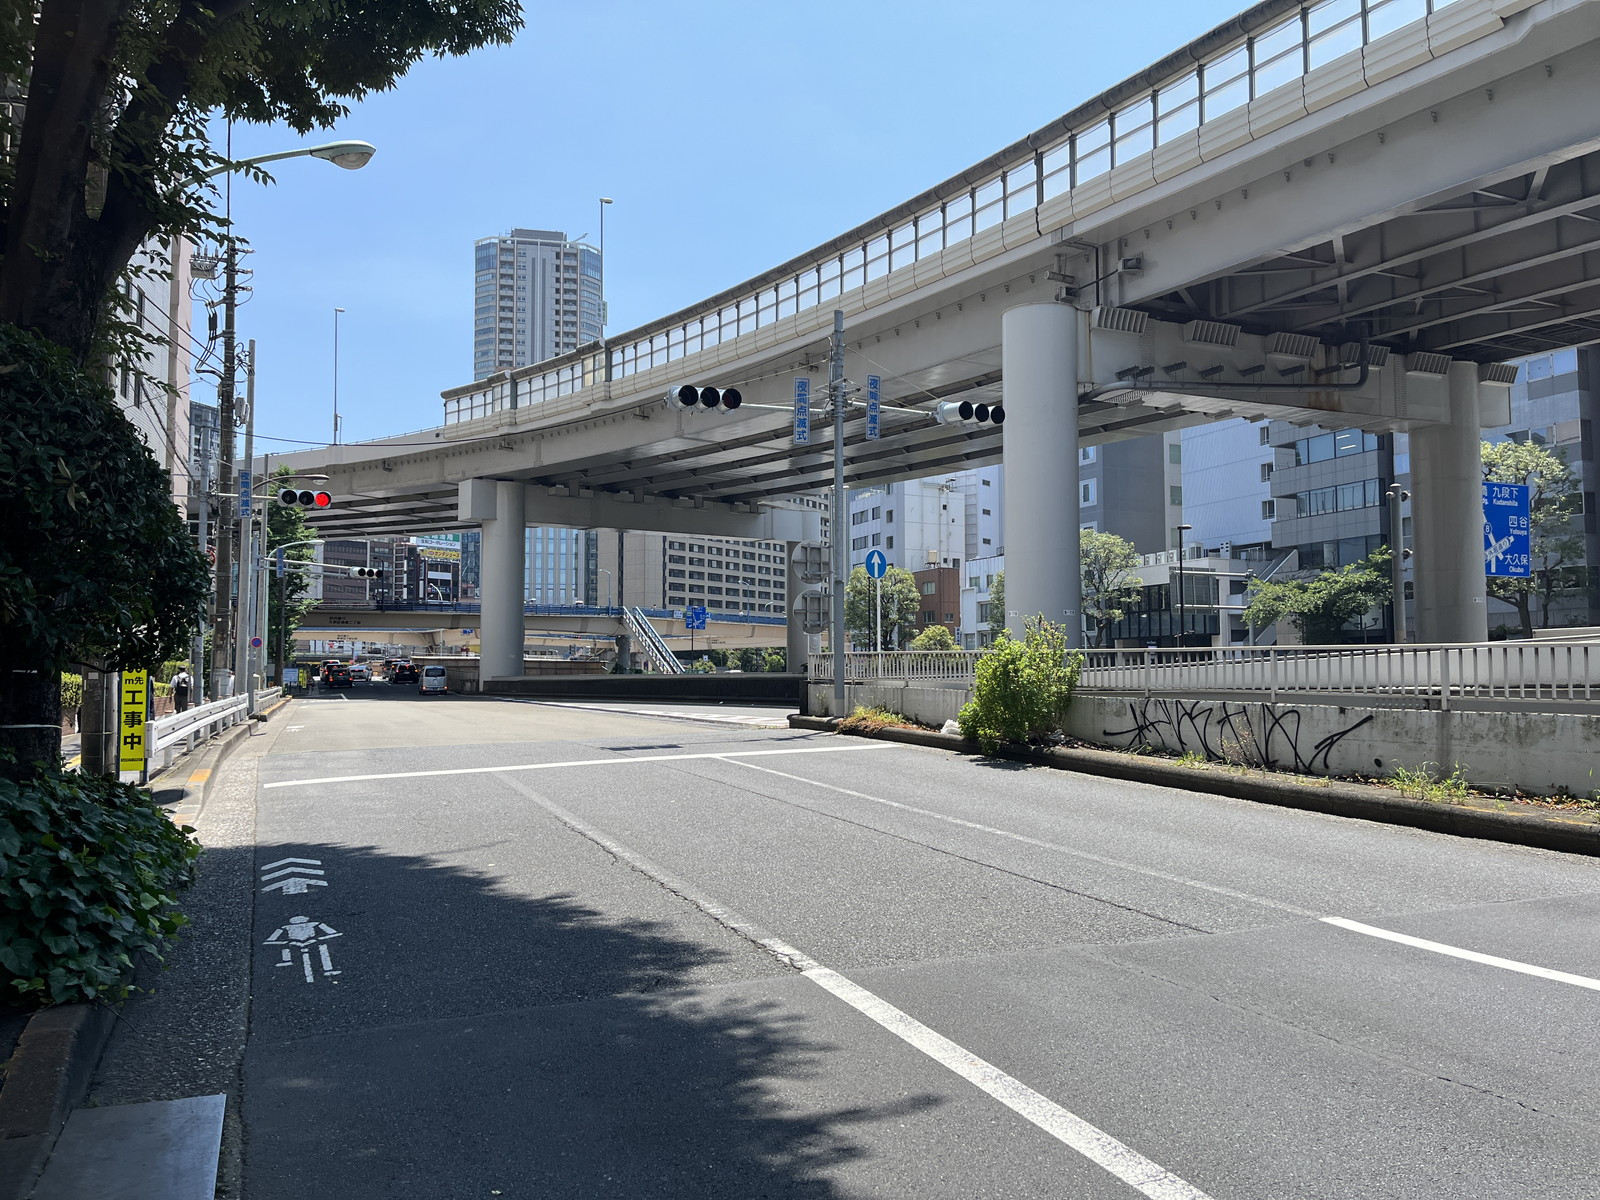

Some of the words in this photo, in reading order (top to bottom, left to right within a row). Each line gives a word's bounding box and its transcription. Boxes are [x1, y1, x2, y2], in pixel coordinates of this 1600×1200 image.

[796, 381, 808, 441] 夜間点滅式
[868, 378, 879, 437] 夜間点滅式
[1492, 486, 1519, 499] 九段下
[1508, 515, 1528, 528] 四谷
[1504, 553, 1529, 565] 大久保
[124, 676, 144, 685] m先
[123, 690, 144, 751] 工事中
